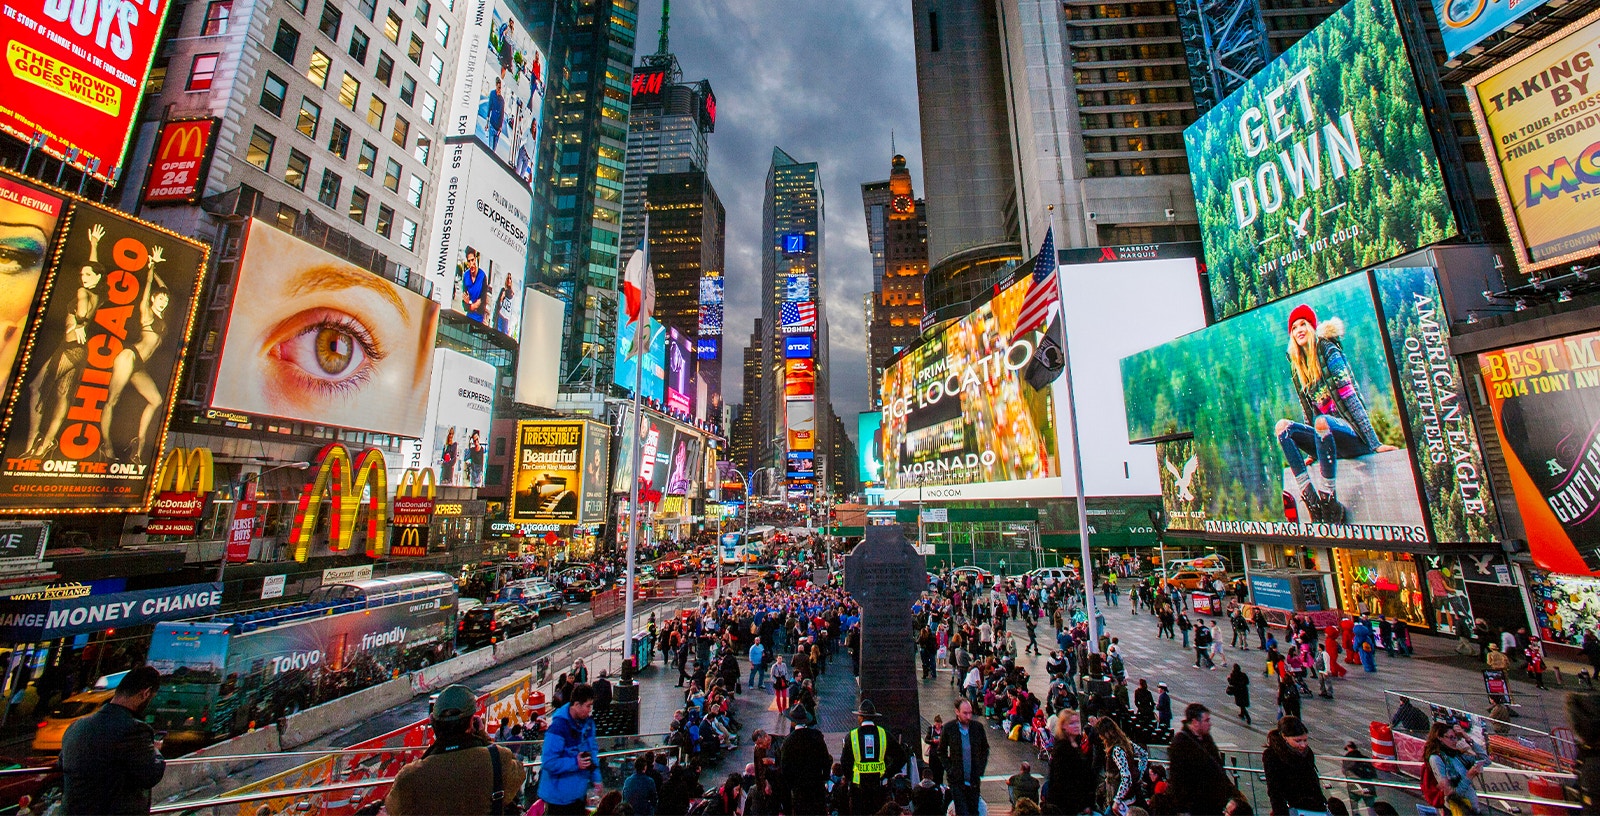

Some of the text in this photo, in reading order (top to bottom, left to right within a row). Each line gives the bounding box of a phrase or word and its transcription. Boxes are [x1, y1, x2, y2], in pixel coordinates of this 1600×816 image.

[3, 5, 16, 18] THE
[16, 14, 39, 32] STORY
[38, 24, 47, 35] OF
[47, 29, 71, 50] FRANKIE
[71, 43, 87, 59] VALLI
[86, 53, 92, 63] &
[92, 56, 103, 69] THE
[14, 58, 64, 88] GOES
[59, 65, 116, 98] CROWD
[1489, 51, 1594, 112] TAKING
[1550, 73, 1591, 107] BY
[1239, 66, 1316, 158] GET
[1501, 132, 1518, 145] ON
[1519, 117, 1551, 137] TOUR
[1505, 137, 1544, 162] FINAL
[161, 161, 195, 170] OPEN
[1230, 111, 1363, 229] DOWN
[161, 172, 187, 186] 24
[20, 195, 53, 214] REVIVAL
[150, 187, 193, 197] HOURS
[1570, 187, 1600, 203] THE
[1119, 245, 1160, 253] MARRIOTT
[1119, 251, 1157, 259] MARQUIS
[1258, 259, 1279, 275] STAY
[1309, 237, 1329, 254] NOT
[60, 237, 149, 459] CHICAGO
[918, 354, 953, 383] PRIME
[1485, 344, 1561, 383] BEST
[1493, 380, 1529, 400] 2014
[1529, 373, 1571, 395] TONY
[1404, 337, 1449, 465] OUTFITTERS
[1413, 291, 1488, 515] AMERICAN EAGLE
[6, 458, 148, 475] THE ONE THE ONLY
[522, 449, 578, 463] Beautiful
[902, 450, 996, 477] VORNADO
[1546, 458, 1567, 477] A
[926, 489, 962, 497] VNO.COM
[434, 504, 462, 515] XPRESS
[232, 517, 256, 530] JERSEY
[234, 529, 251, 541] BOYS
[491, 523, 560, 532] GIFTS LUGGAGE
[1207, 520, 1427, 542] AMERICAN EAGLE OUTFITTERS
[10, 588, 93, 600] MONEY EXCHANGE
[45, 600, 137, 629] MONEY
[141, 591, 223, 616] CHANGE
[409, 602, 433, 612] UNITED
[362, 626, 407, 651] friendly
[272, 649, 321, 676] Tokyo
